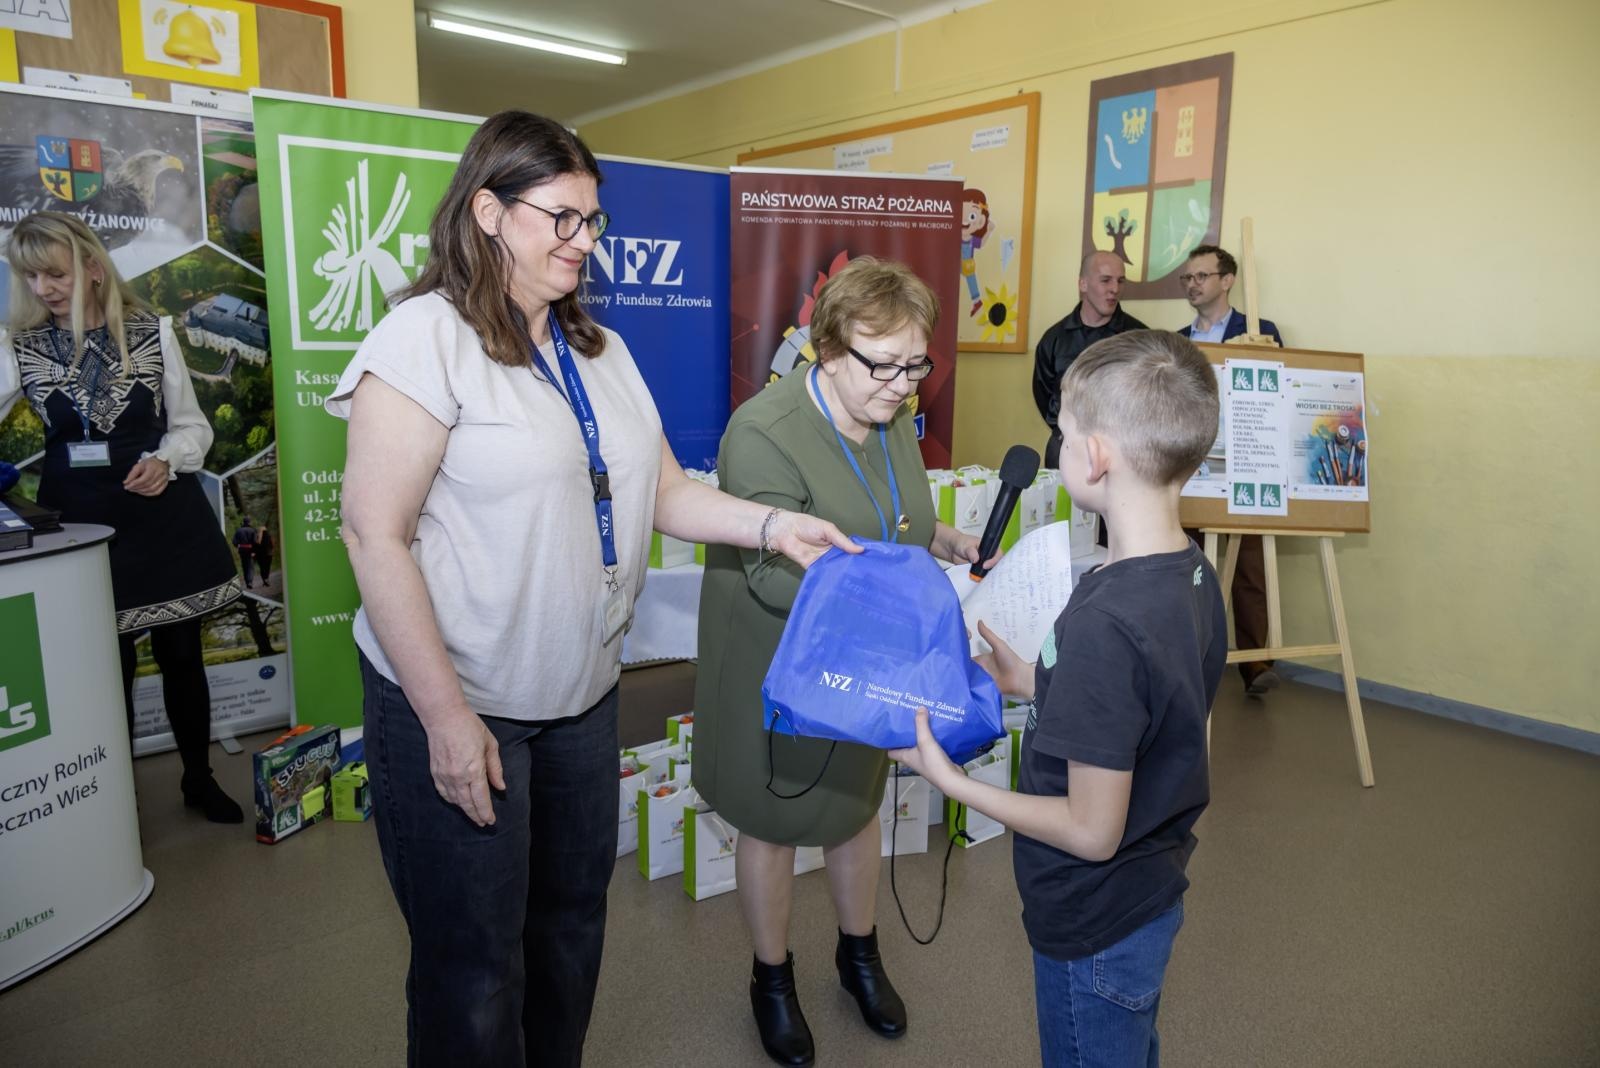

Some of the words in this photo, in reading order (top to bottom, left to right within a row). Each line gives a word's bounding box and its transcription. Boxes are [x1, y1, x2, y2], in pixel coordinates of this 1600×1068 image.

[741, 189, 838, 209] PAŃSTWOWA
[841, 194, 885, 211] STRAŻ
[888, 196, 953, 214] POŻARNA
[741, 216, 774, 224] KOMENDA
[775, 217, 813, 225] POWIATOWA
[814, 218, 855, 227] PAŃSTWOWEJ
[919, 222, 953, 230] RACIBORZU
[585, 236, 684, 286] NFZ
[616, 293, 663, 306] Fundusz
[666, 294, 713, 308] Zdrowia
[295, 370, 341, 385] Kasa
[1295, 402, 1319, 410] WIOSKI
[1320, 403, 1332, 411] BEZ
[583, 420, 597, 438] NFZ
[303, 490, 324, 503] ul.
[328, 489, 342, 503] J
[305, 529, 330, 541] tel.
[601, 513, 609, 536] NFZ
[819, 671, 852, 692] NFZ
[866, 682, 903, 698] Narodowy
[905, 693, 935, 707] Fundusz
[936, 701, 966, 715] Zdrowia
[54, 744, 108, 782] Rolnik
[277, 753, 307, 788] SPY
[306, 741, 337, 762] GUY
[56, 776, 99, 809] Wieś
[0, 906, 55, 941] .pl/krus
